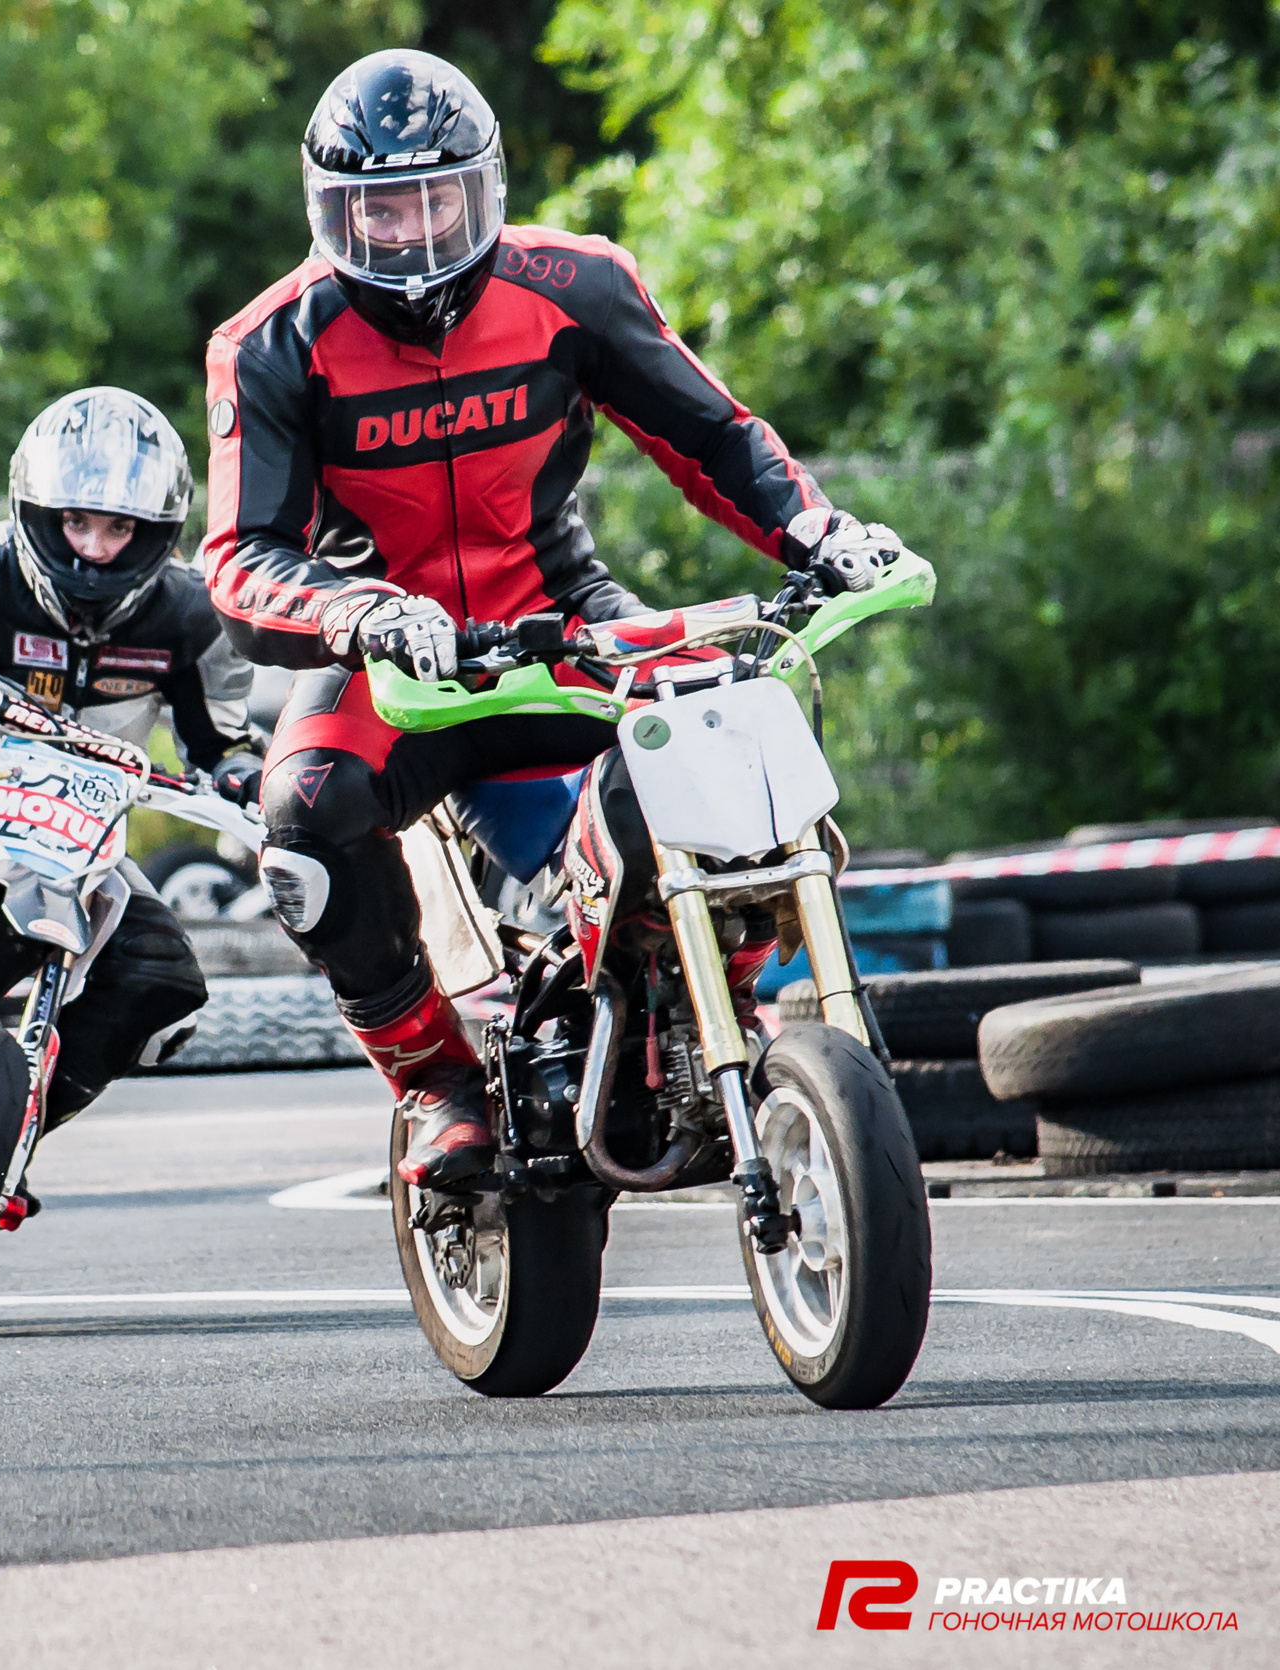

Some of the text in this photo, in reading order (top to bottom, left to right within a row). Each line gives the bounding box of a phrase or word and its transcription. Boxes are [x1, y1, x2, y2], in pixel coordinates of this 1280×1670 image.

[361, 150, 441, 171] LS2
[502, 246, 577, 289] 999
[354, 384, 529, 452] DUCATI
[18, 635, 64, 662] LSL
